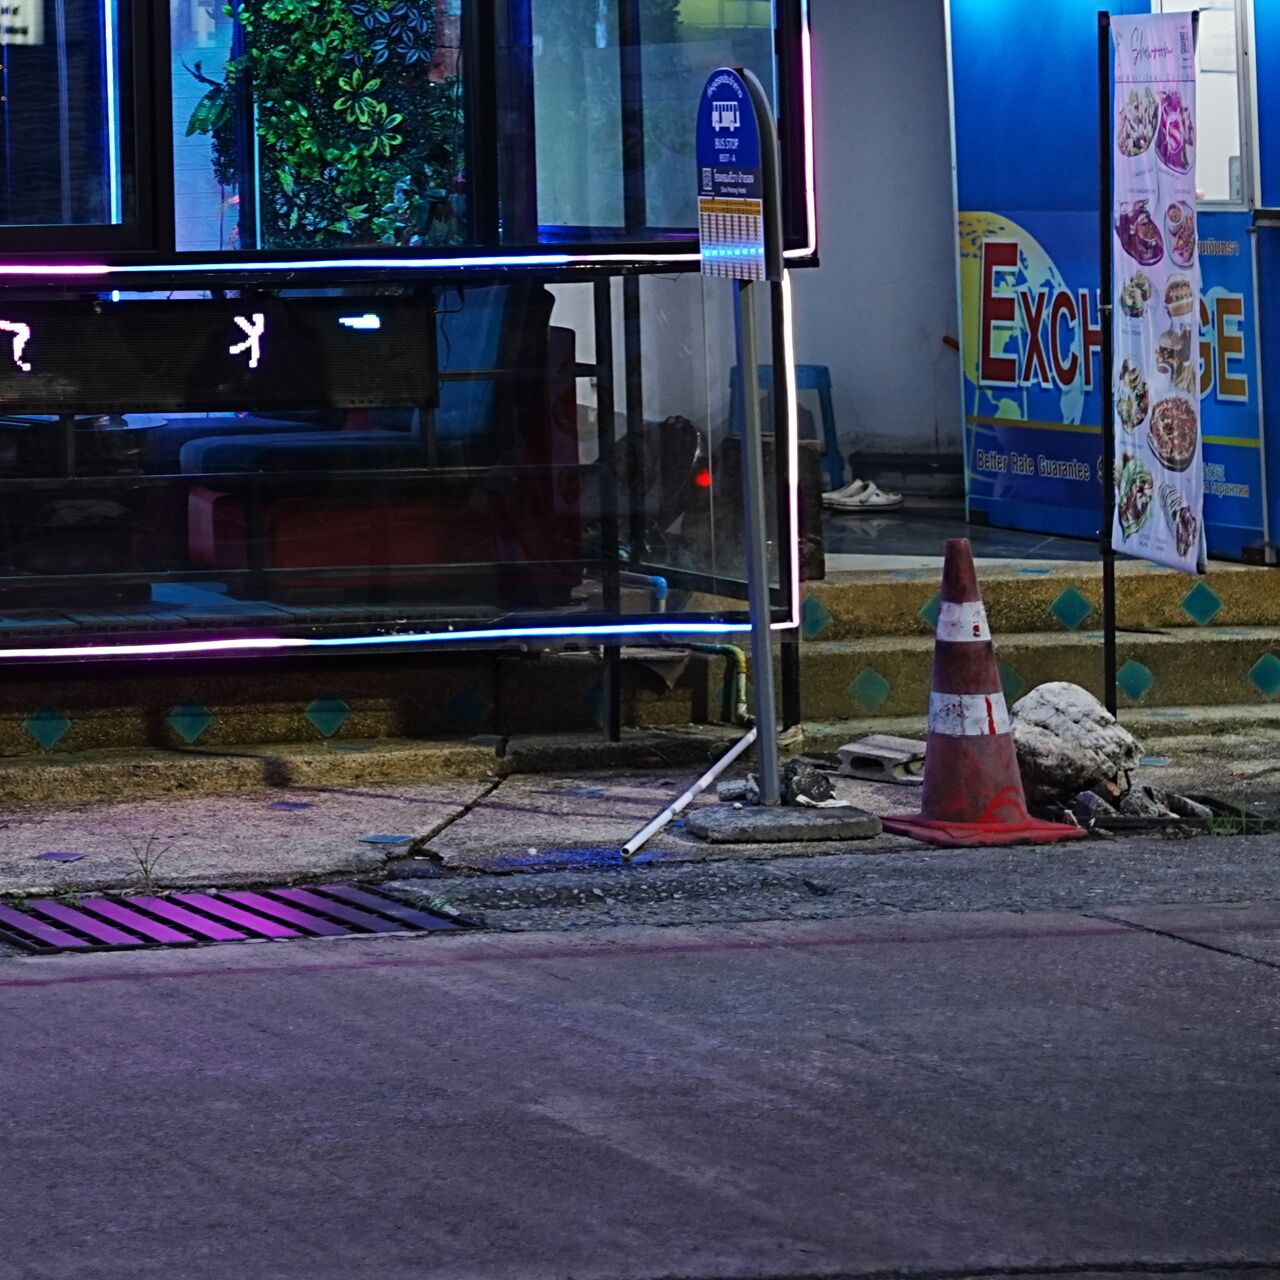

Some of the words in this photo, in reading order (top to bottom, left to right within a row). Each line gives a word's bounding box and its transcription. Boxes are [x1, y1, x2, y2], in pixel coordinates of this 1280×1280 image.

[976, 448, 1009, 476] Better
[1010, 451, 1036, 475] Rate
[1037, 454, 1091, 482] Guarantee
